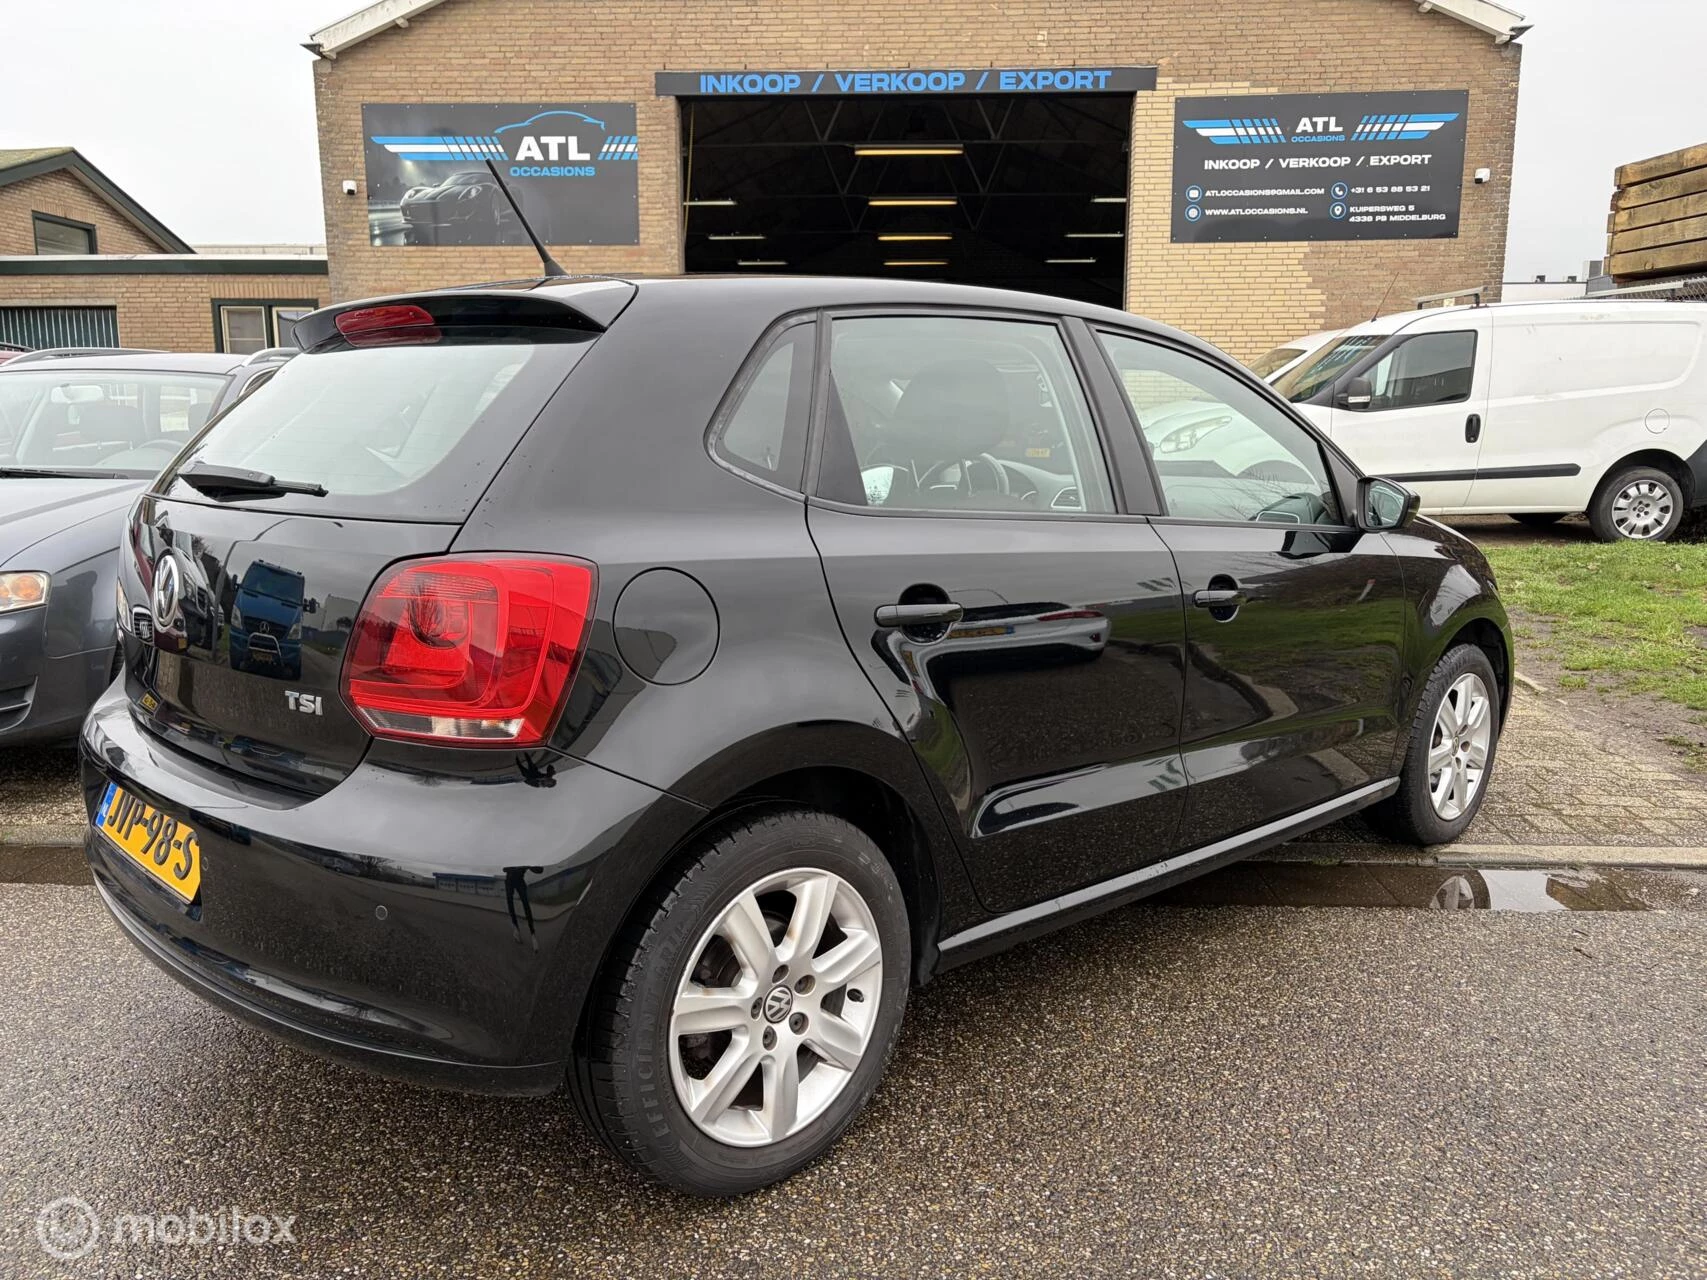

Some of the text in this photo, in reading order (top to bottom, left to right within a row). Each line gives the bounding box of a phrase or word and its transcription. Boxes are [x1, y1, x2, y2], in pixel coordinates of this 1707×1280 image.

[699, 69, 1113, 94] INKOOP / VERKOOP / EXPORT
[1295, 116, 1344, 133] ATL
[1290, 134, 1346, 143] OCCASIONS
[515, 135, 591, 161] ATL
[1203, 153, 1433, 171] INKOOP / VERKOOP / EXPORT
[509, 165, 596, 177] OCCASIONS
[1204, 207, 1309, 216] WWW.ATLOCCASIONS.NL
[1349, 204, 1407, 213] KUIPERSWEG
[1389, 213, 1447, 222] MIDDELBURG
[284, 690, 323, 716] TSI
[107, 789, 200, 881] JVP-98-S
